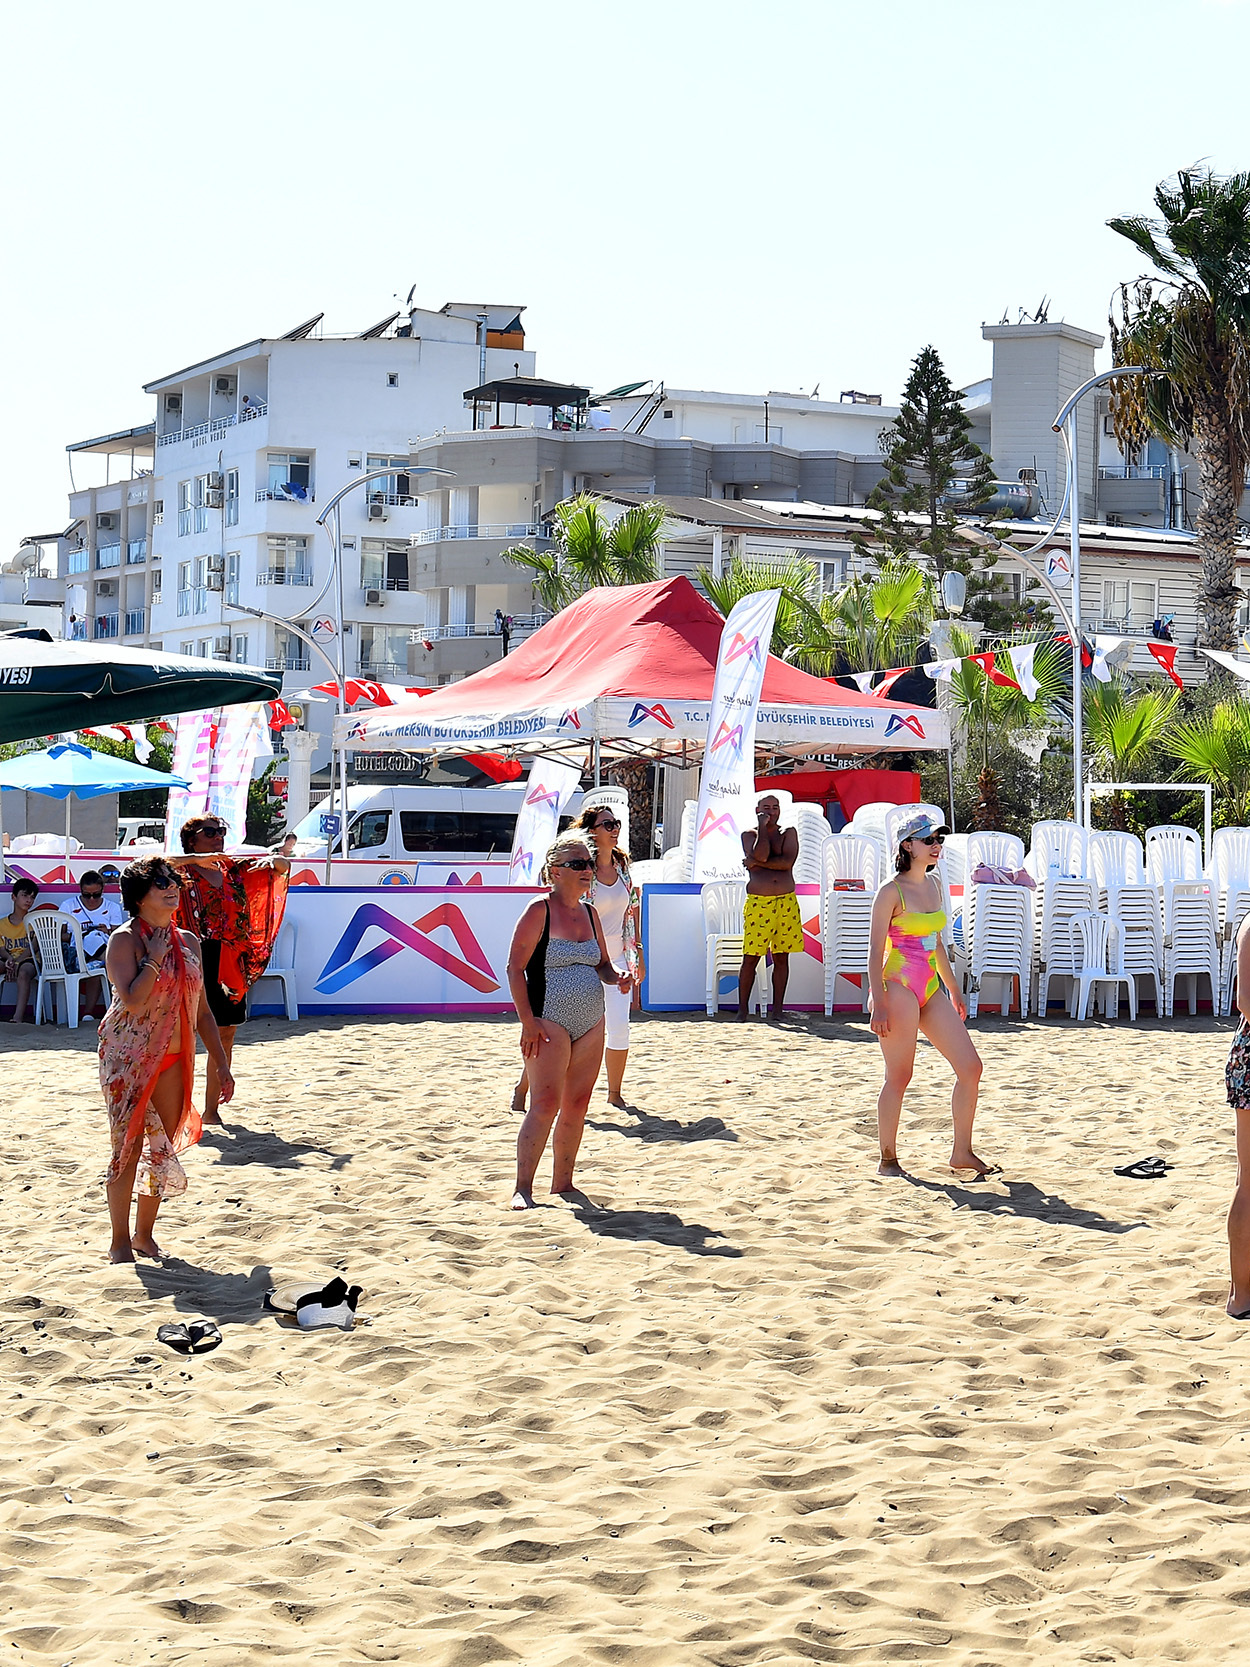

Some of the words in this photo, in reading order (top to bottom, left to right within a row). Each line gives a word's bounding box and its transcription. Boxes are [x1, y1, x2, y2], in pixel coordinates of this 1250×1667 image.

[684, 712, 704, 722] T.C.
[757, 711, 817, 726] ÜYÜKŞEHİR
[820, 715, 875, 728] BELEDİYESİ
[354, 756, 387, 771] HOTEL
[388, 756, 416, 771] GOLD
